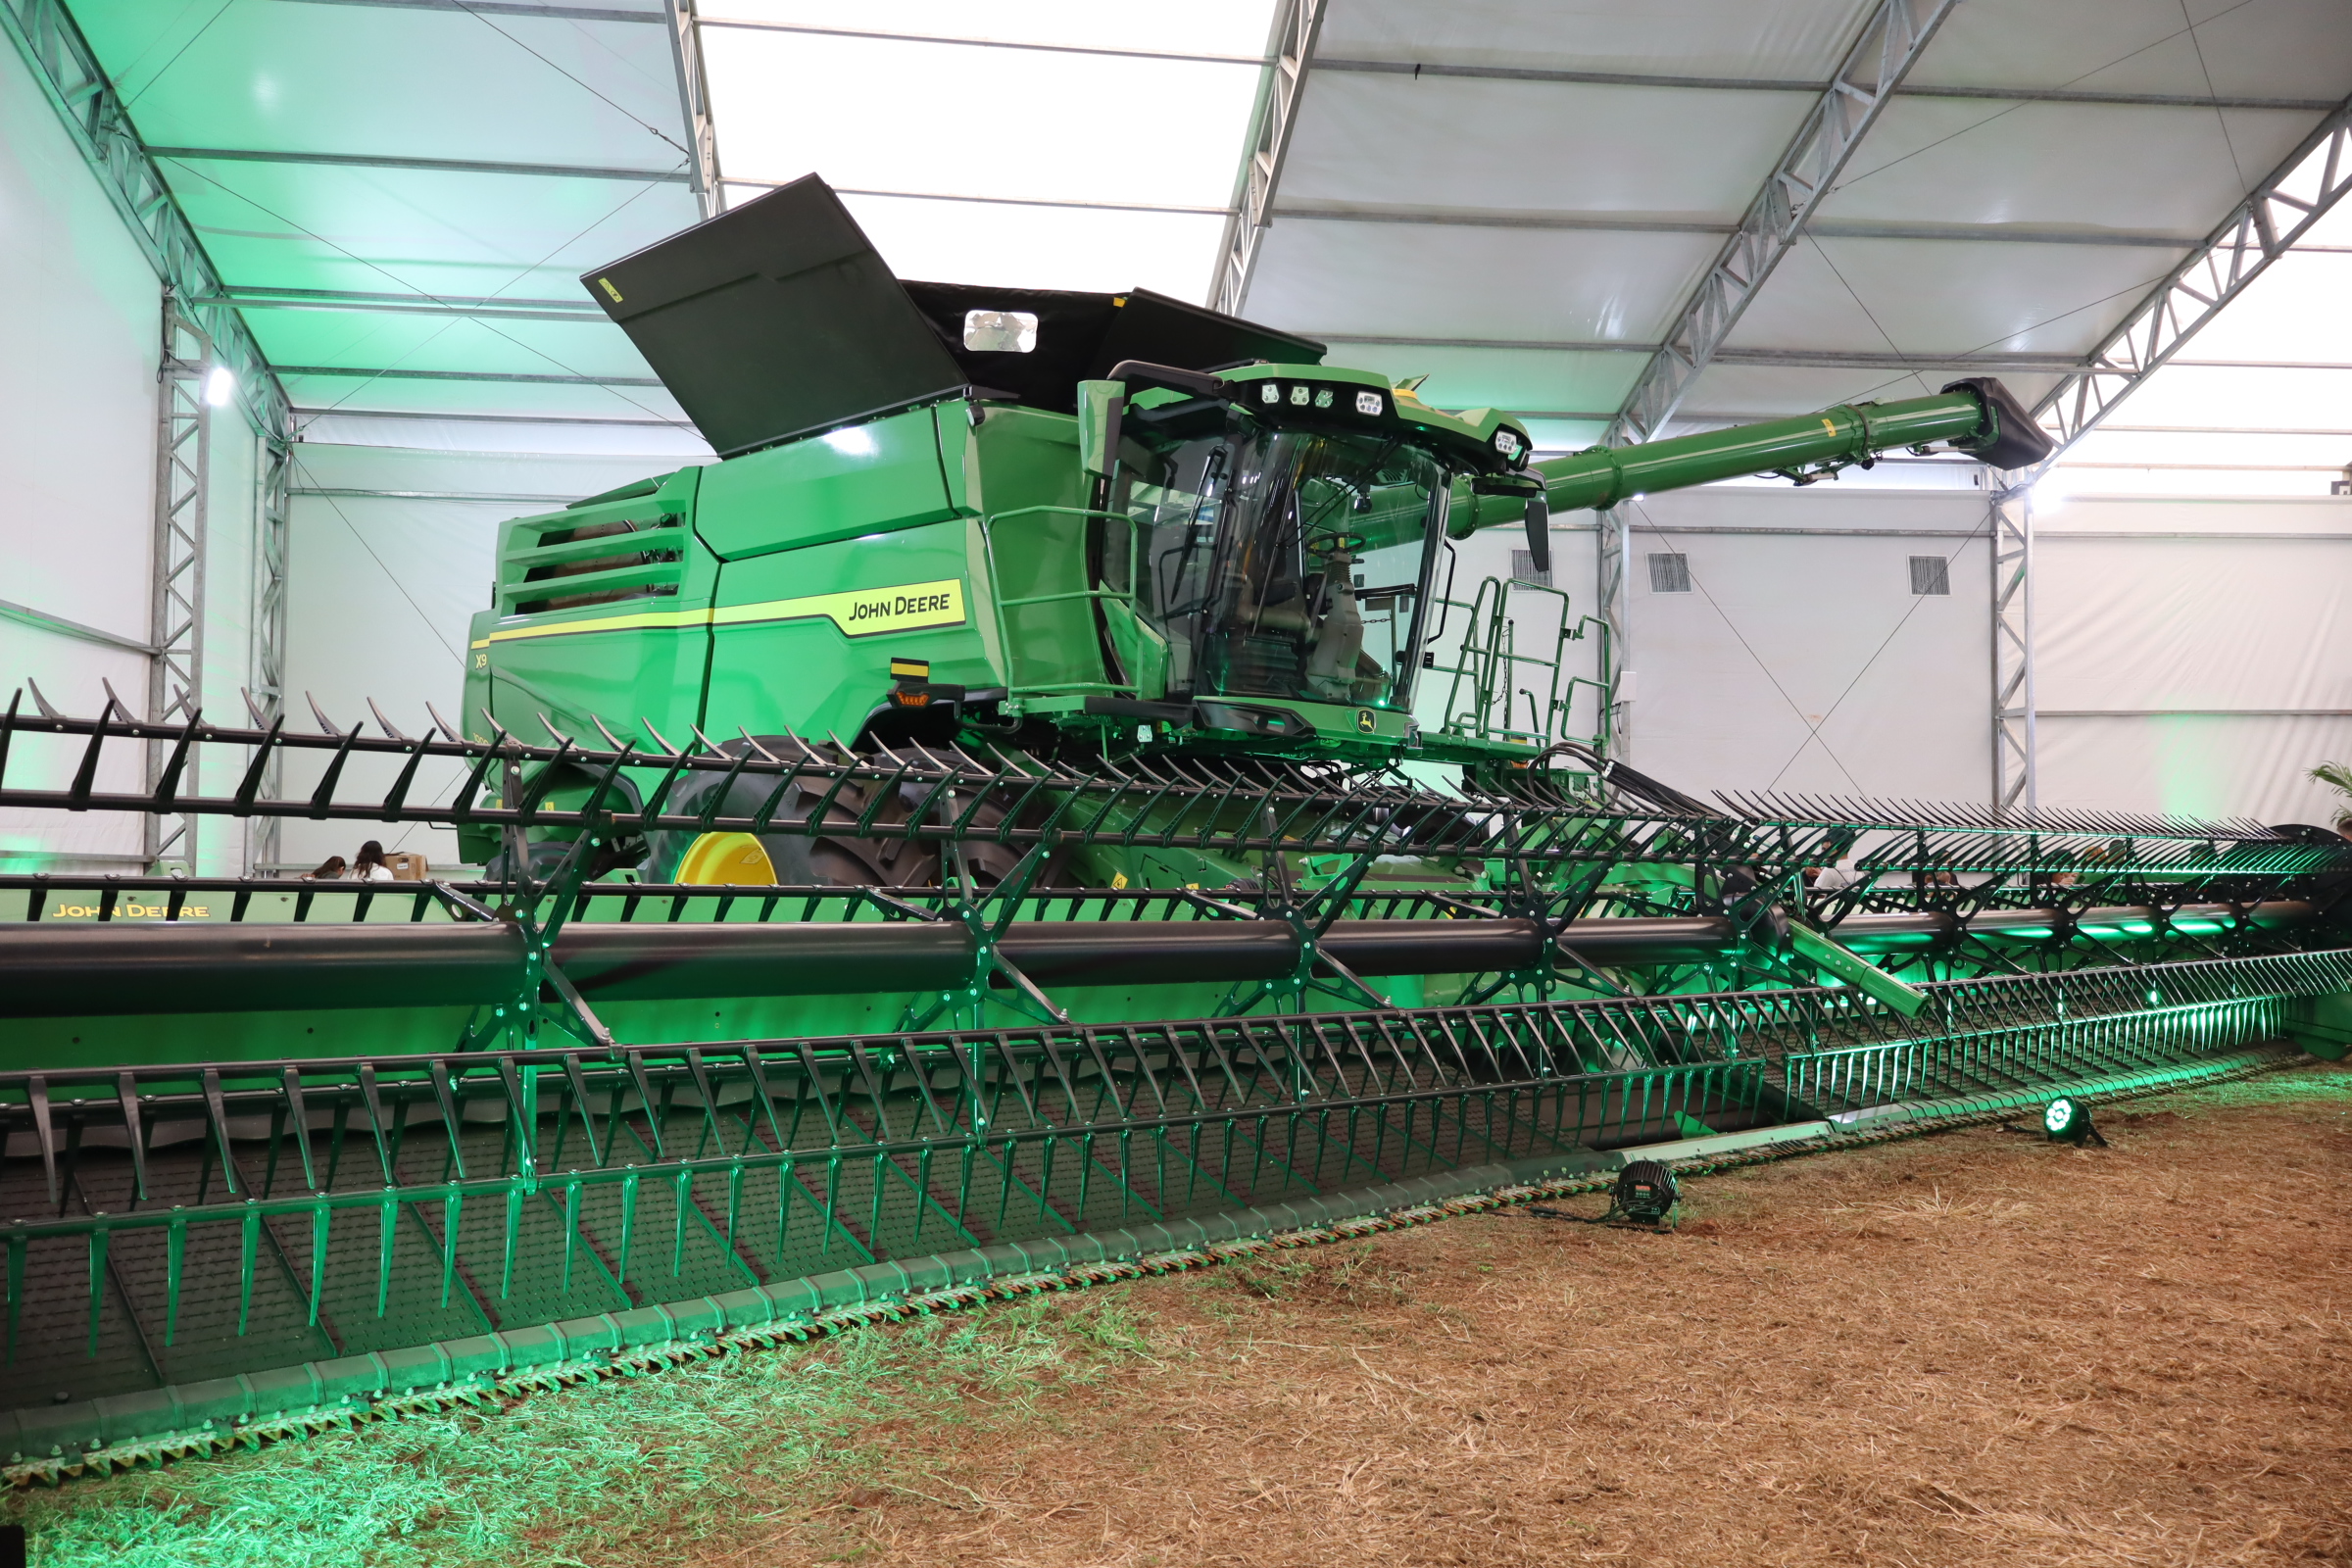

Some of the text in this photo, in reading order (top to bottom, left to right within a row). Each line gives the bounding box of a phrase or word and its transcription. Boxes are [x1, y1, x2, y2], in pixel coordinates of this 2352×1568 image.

[849, 593, 951, 621] JOHN DEERE
[475, 653, 487, 668] X9
